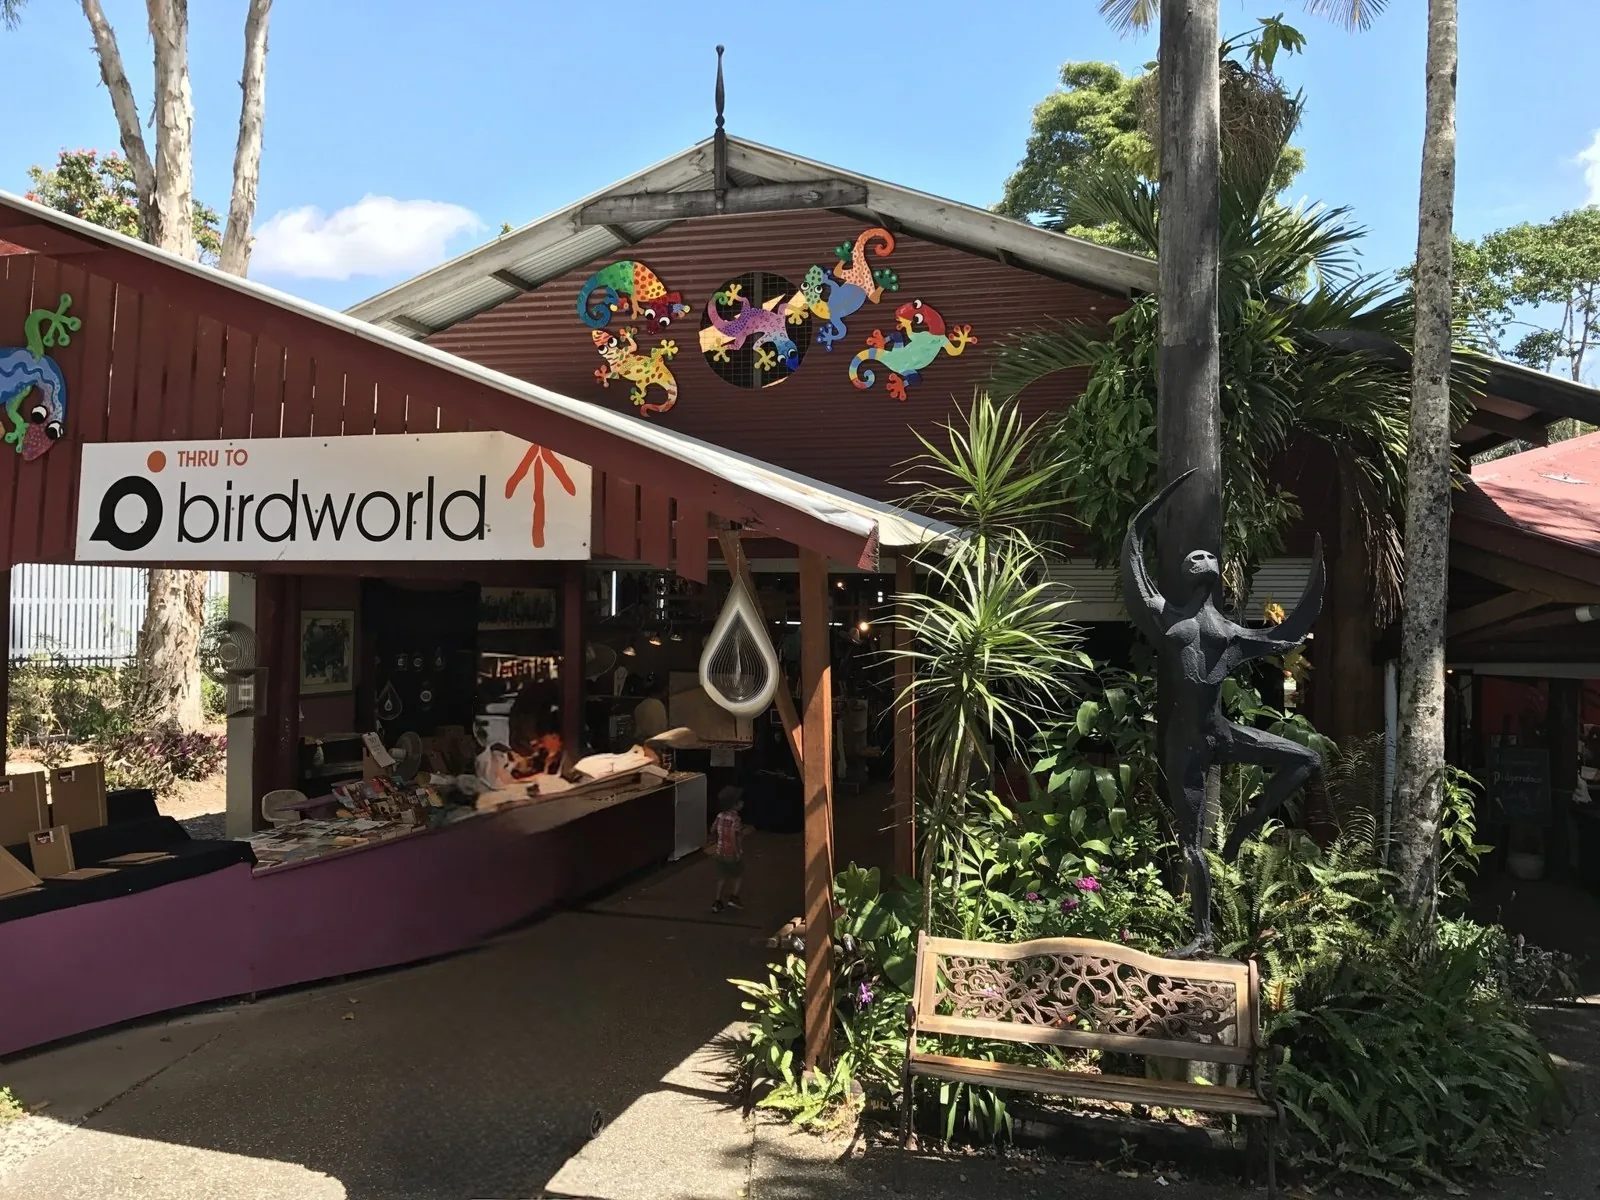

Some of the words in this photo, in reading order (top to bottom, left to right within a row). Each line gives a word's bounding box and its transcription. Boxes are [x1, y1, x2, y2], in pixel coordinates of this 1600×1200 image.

[177, 450, 219, 467] THRU
[225, 449, 248, 466] TO
[177, 475, 487, 543] birdworld
